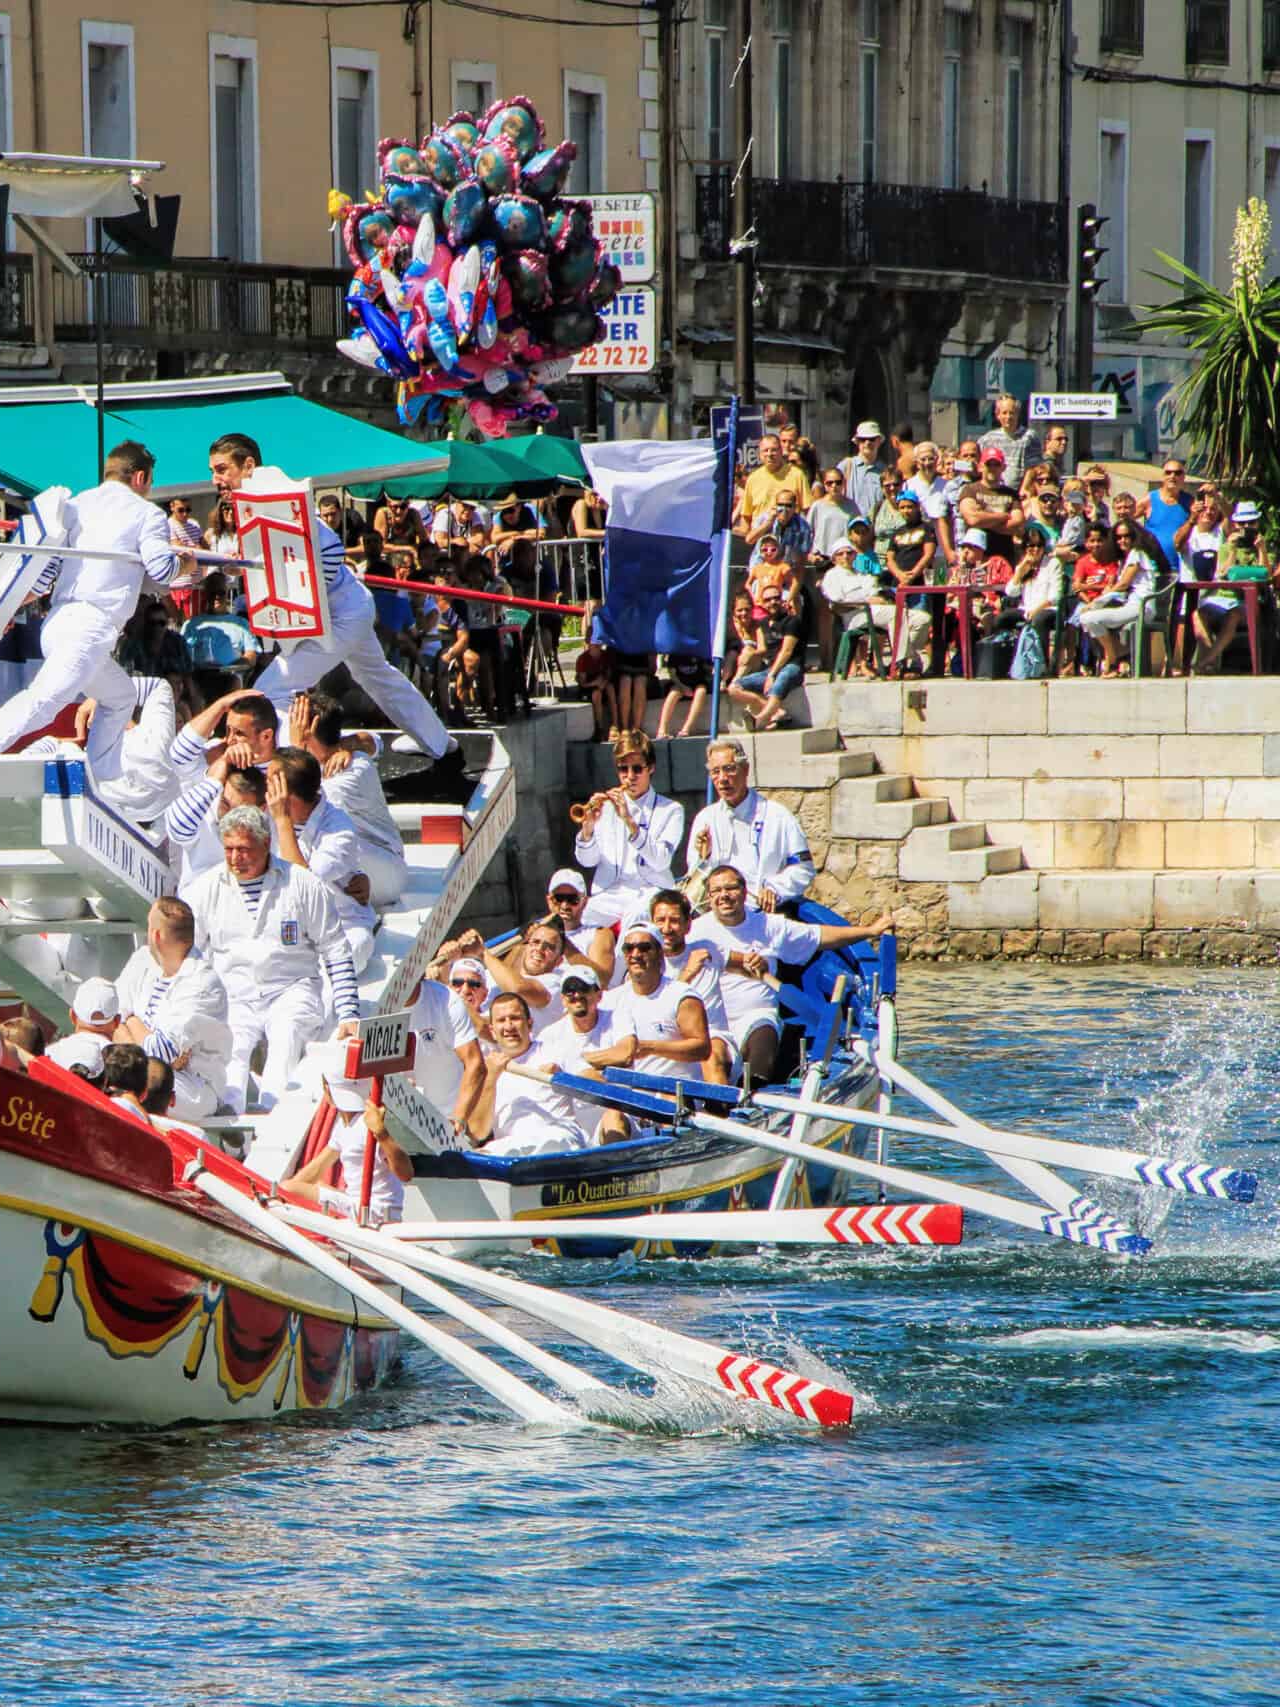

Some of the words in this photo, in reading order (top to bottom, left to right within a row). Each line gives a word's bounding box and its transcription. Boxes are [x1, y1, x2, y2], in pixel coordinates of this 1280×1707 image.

[609, 322, 638, 341] ER
[578, 346, 598, 366] 22
[603, 347, 623, 365] 72
[629, 346, 648, 365] 72
[1, 1096, 56, 1139] Sète
